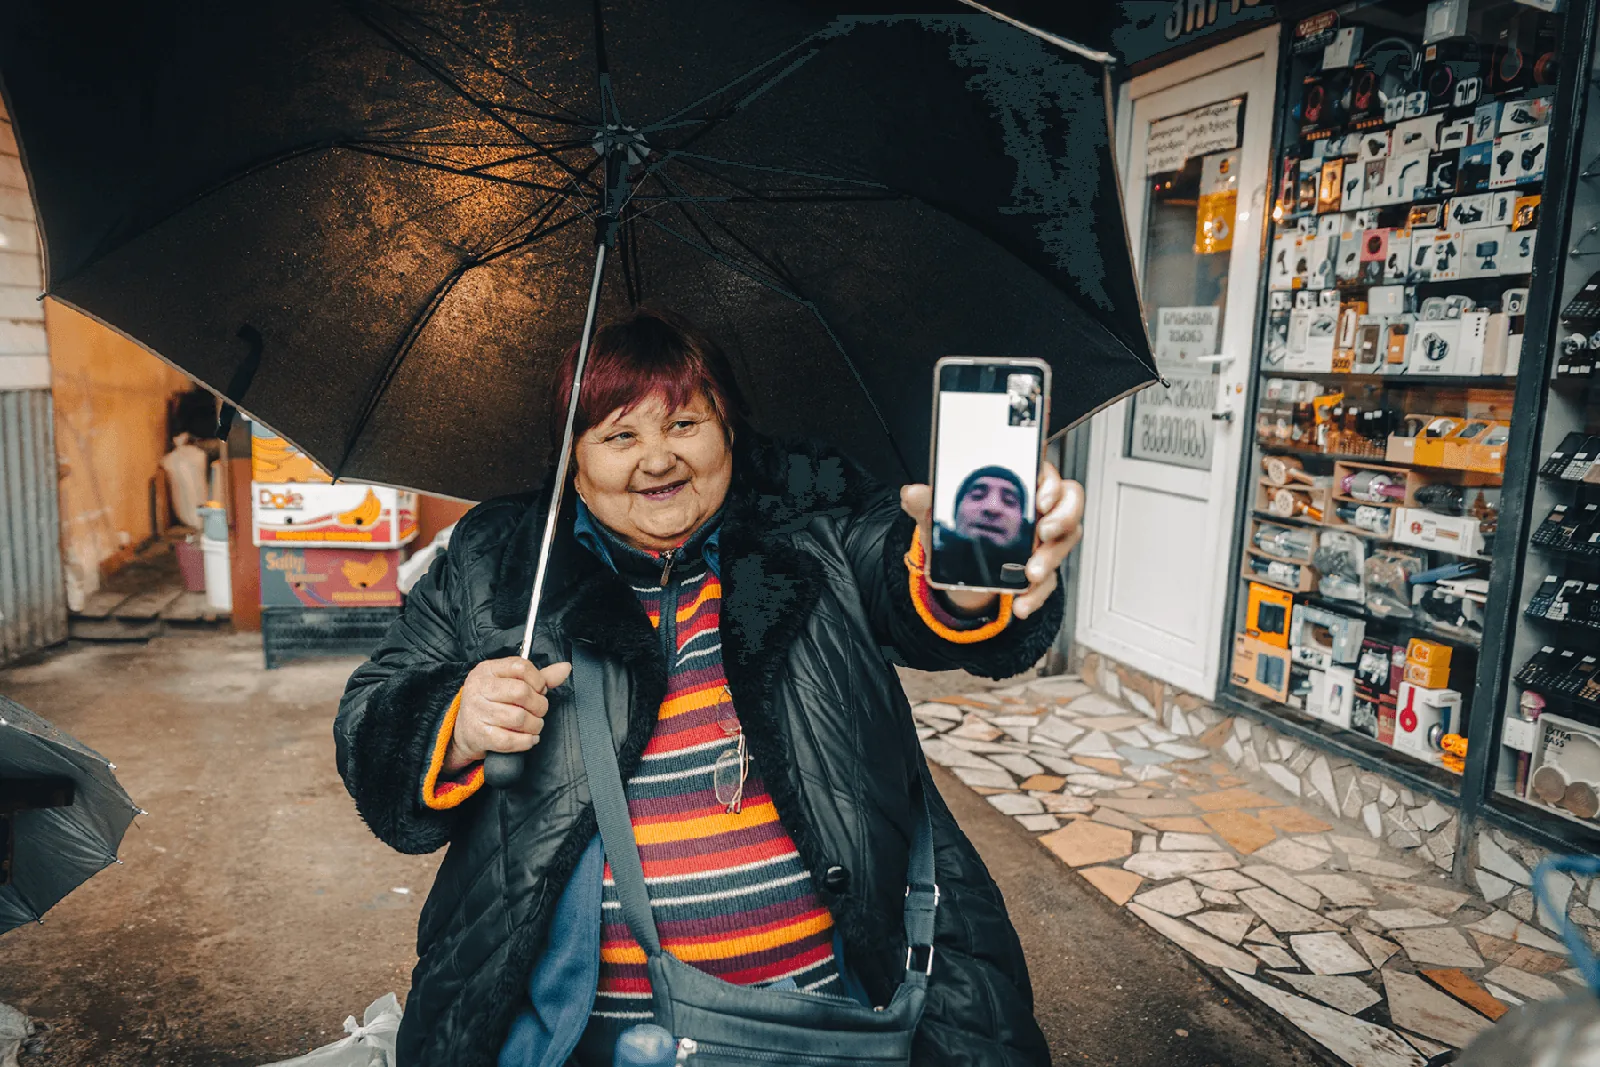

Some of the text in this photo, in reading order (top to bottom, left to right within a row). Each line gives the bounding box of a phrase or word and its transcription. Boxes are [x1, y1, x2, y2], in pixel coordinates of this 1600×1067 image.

[259, 488, 304, 509] Dole
[1544, 734, 1565, 748] BASS
[1545, 726, 1572, 742] EXTRA
